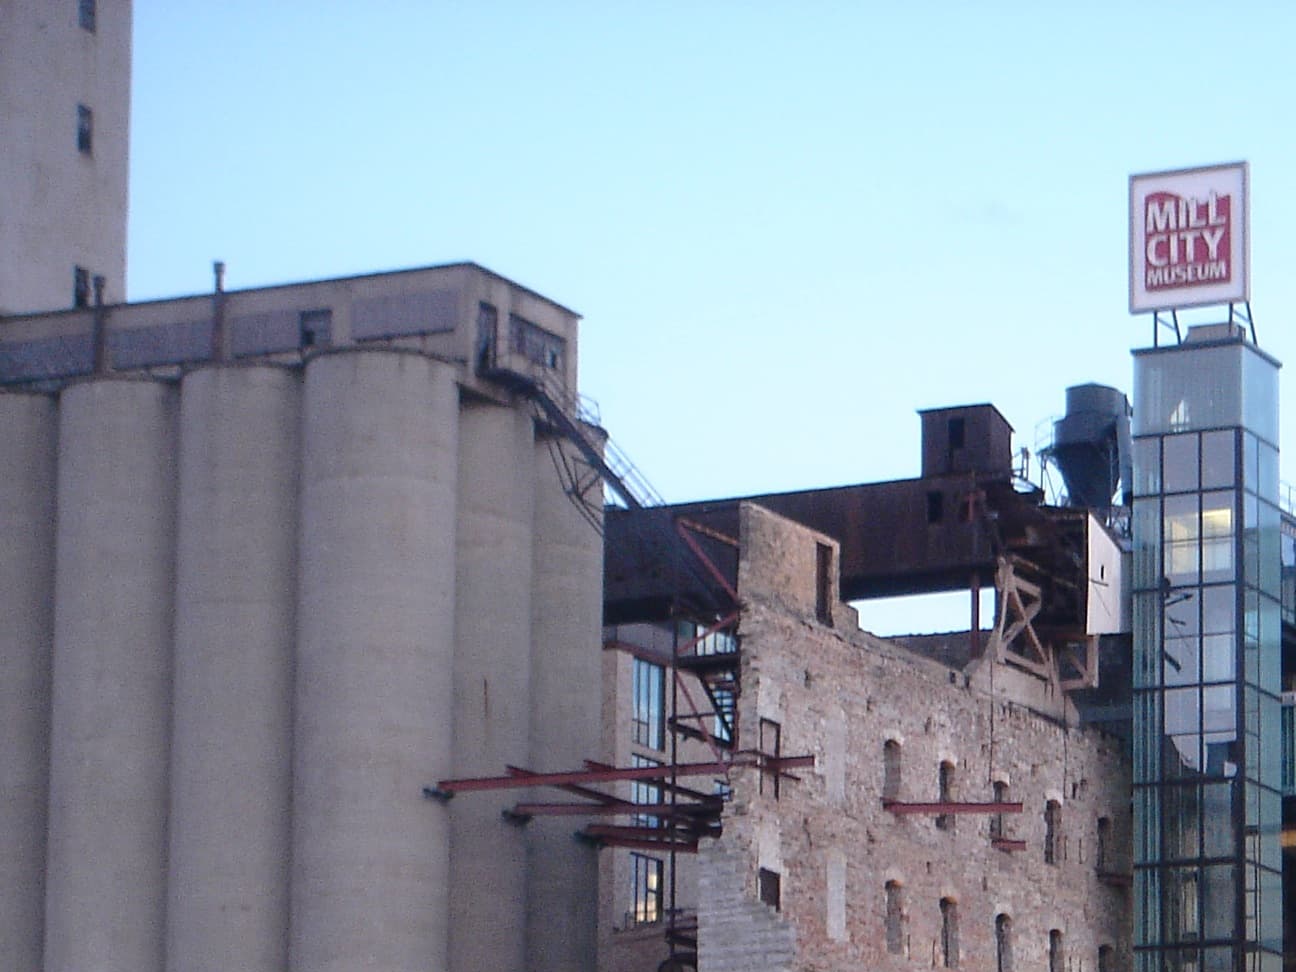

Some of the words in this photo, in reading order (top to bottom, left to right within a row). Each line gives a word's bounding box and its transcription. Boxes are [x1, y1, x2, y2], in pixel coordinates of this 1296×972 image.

[1147, 190, 1226, 232] MILL
[1147, 229, 1225, 267] CITY
[1147, 262, 1226, 287] MUSEUM
